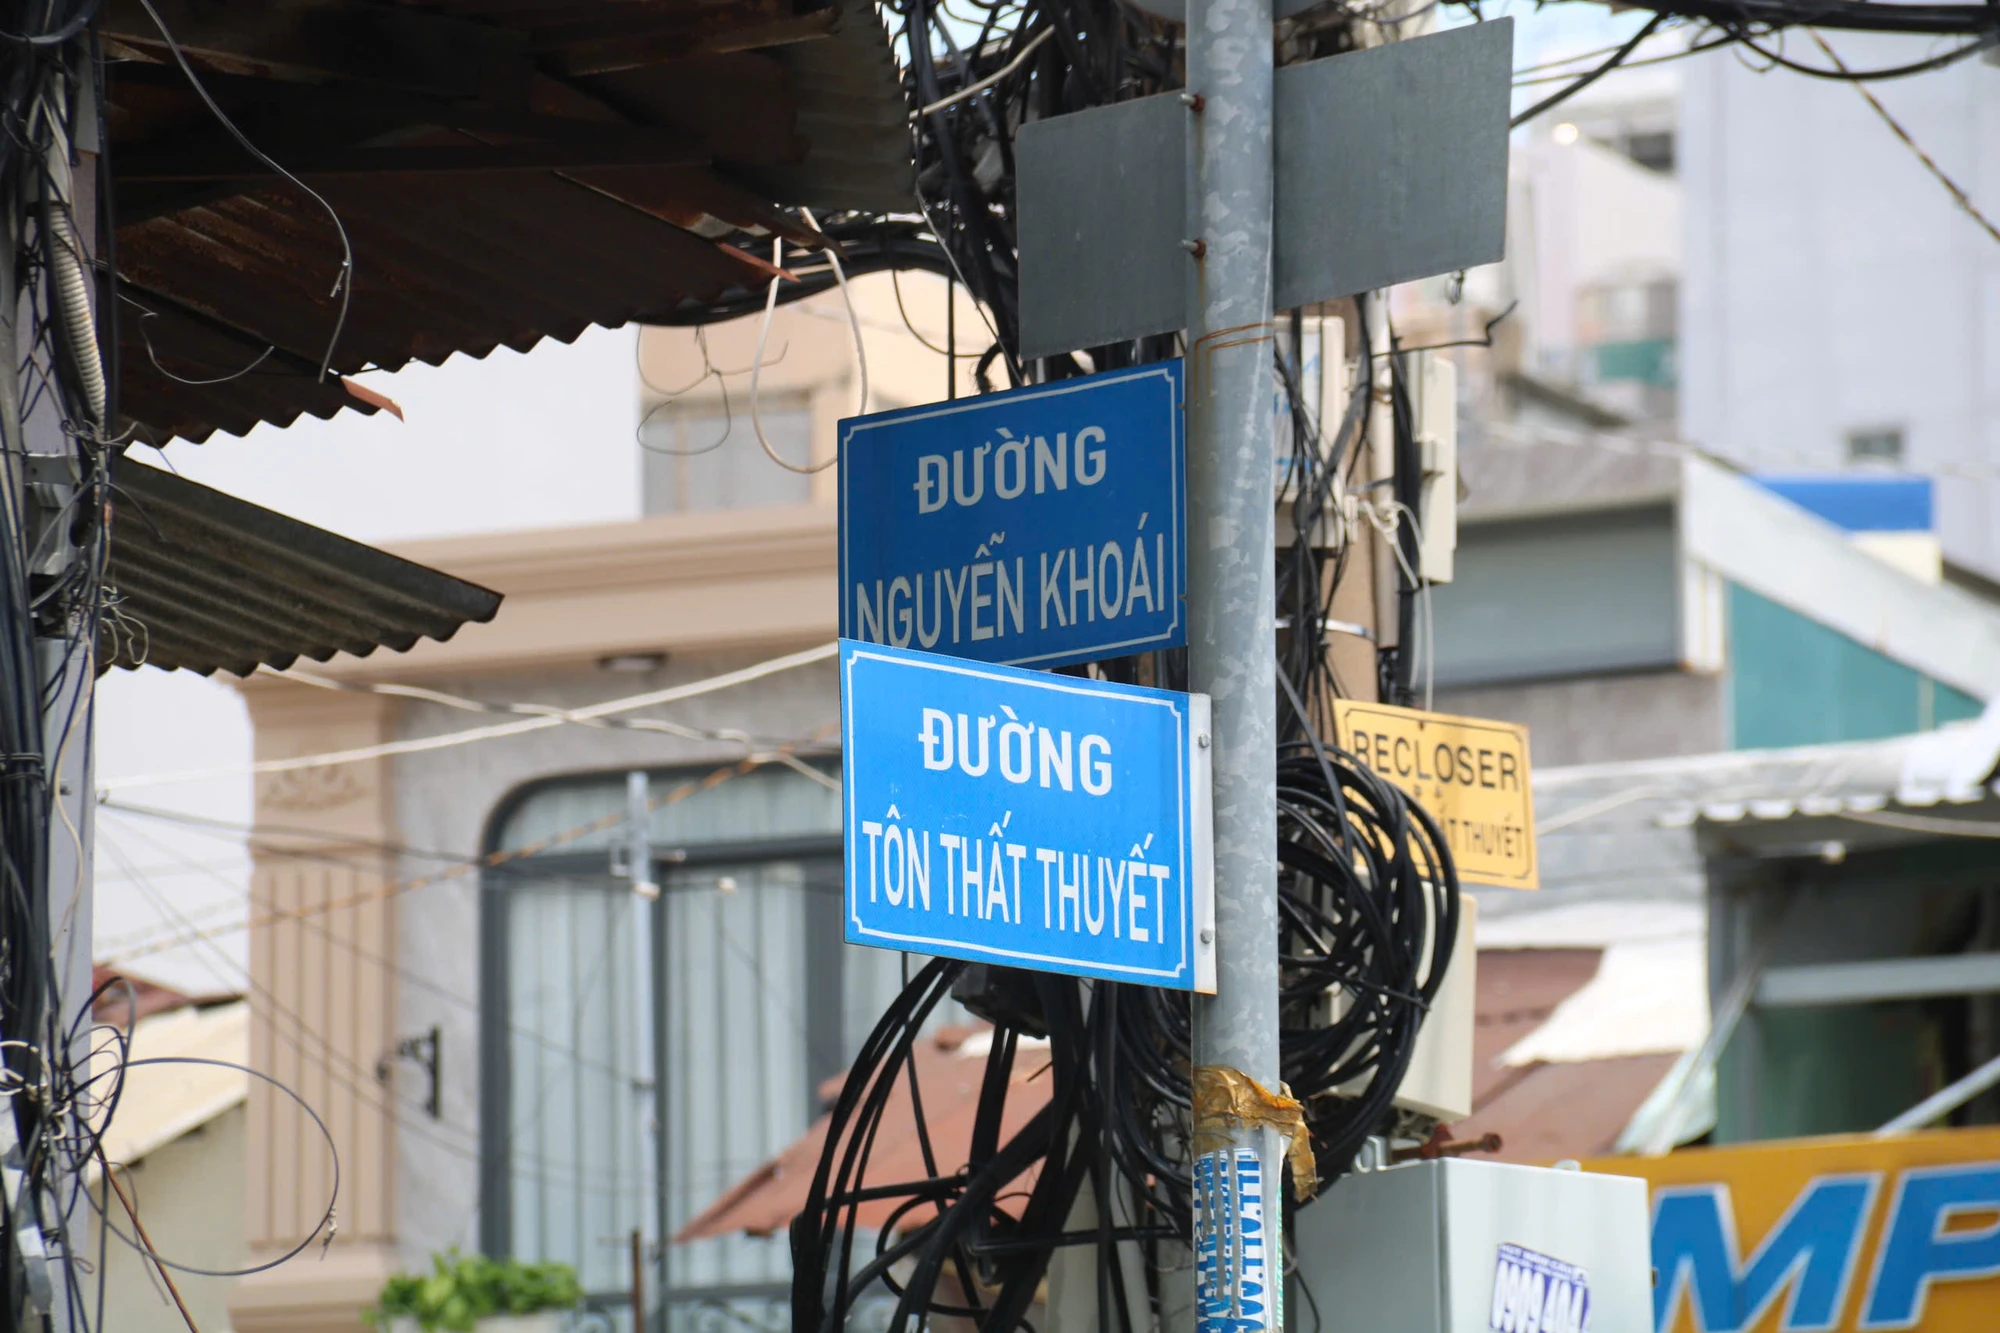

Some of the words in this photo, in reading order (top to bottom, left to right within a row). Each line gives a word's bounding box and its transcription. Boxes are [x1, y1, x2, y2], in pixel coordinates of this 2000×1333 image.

[914, 426, 1107, 514] ĐƯỜNG
[856, 531, 1024, 650] NGUYỄN
[1040, 512, 1165, 630] KHOÁI
[918, 705, 1113, 797] ĐƯỜNG
[1353, 730, 1520, 792] RECLOSER
[862, 804, 931, 912] TÔN
[939, 810, 1027, 928] THẤT
[1036, 833, 1170, 945] THUYẾT
